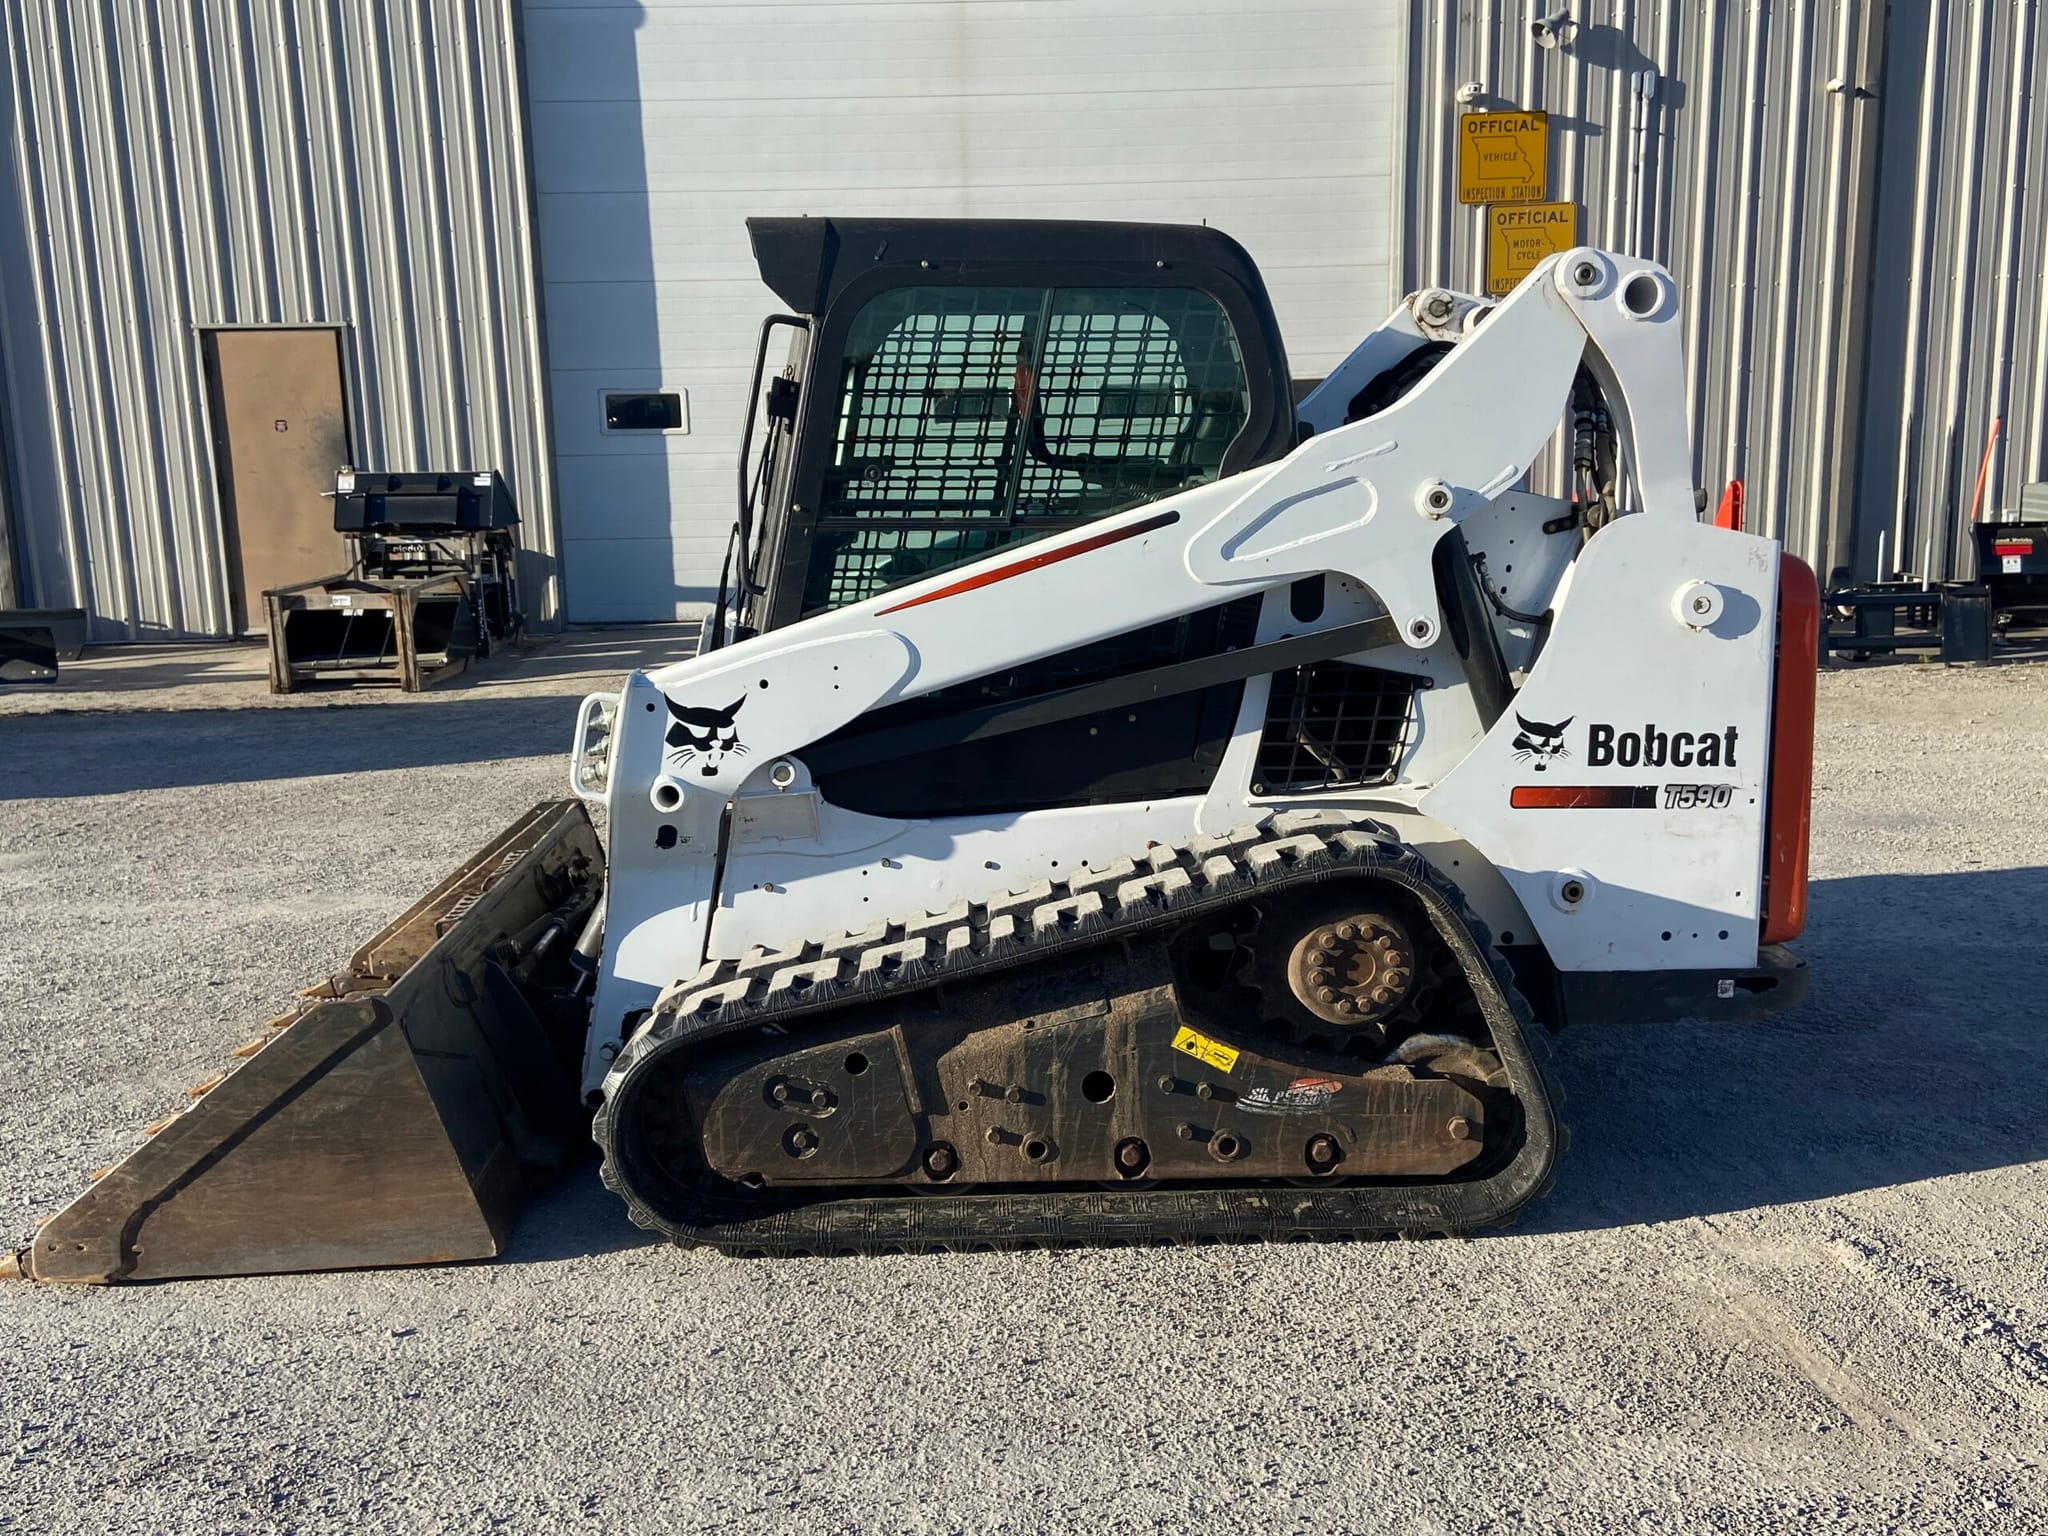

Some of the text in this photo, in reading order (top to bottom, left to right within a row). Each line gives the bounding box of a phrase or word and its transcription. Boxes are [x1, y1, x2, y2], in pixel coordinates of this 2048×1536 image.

[1467, 119, 1540, 134] OFFICIAL
[1483, 151, 1519, 162] VEHICLE
[1463, 186, 1541, 201] INSPECTION STATION
[1496, 211, 1569, 226] OFFICIAL
[1513, 239, 1545, 249] MOTOR-
[1516, 252, 1541, 261] CYCLE
[1587, 723, 1739, 768] Bobcat
[1663, 783, 1733, 810] T590
